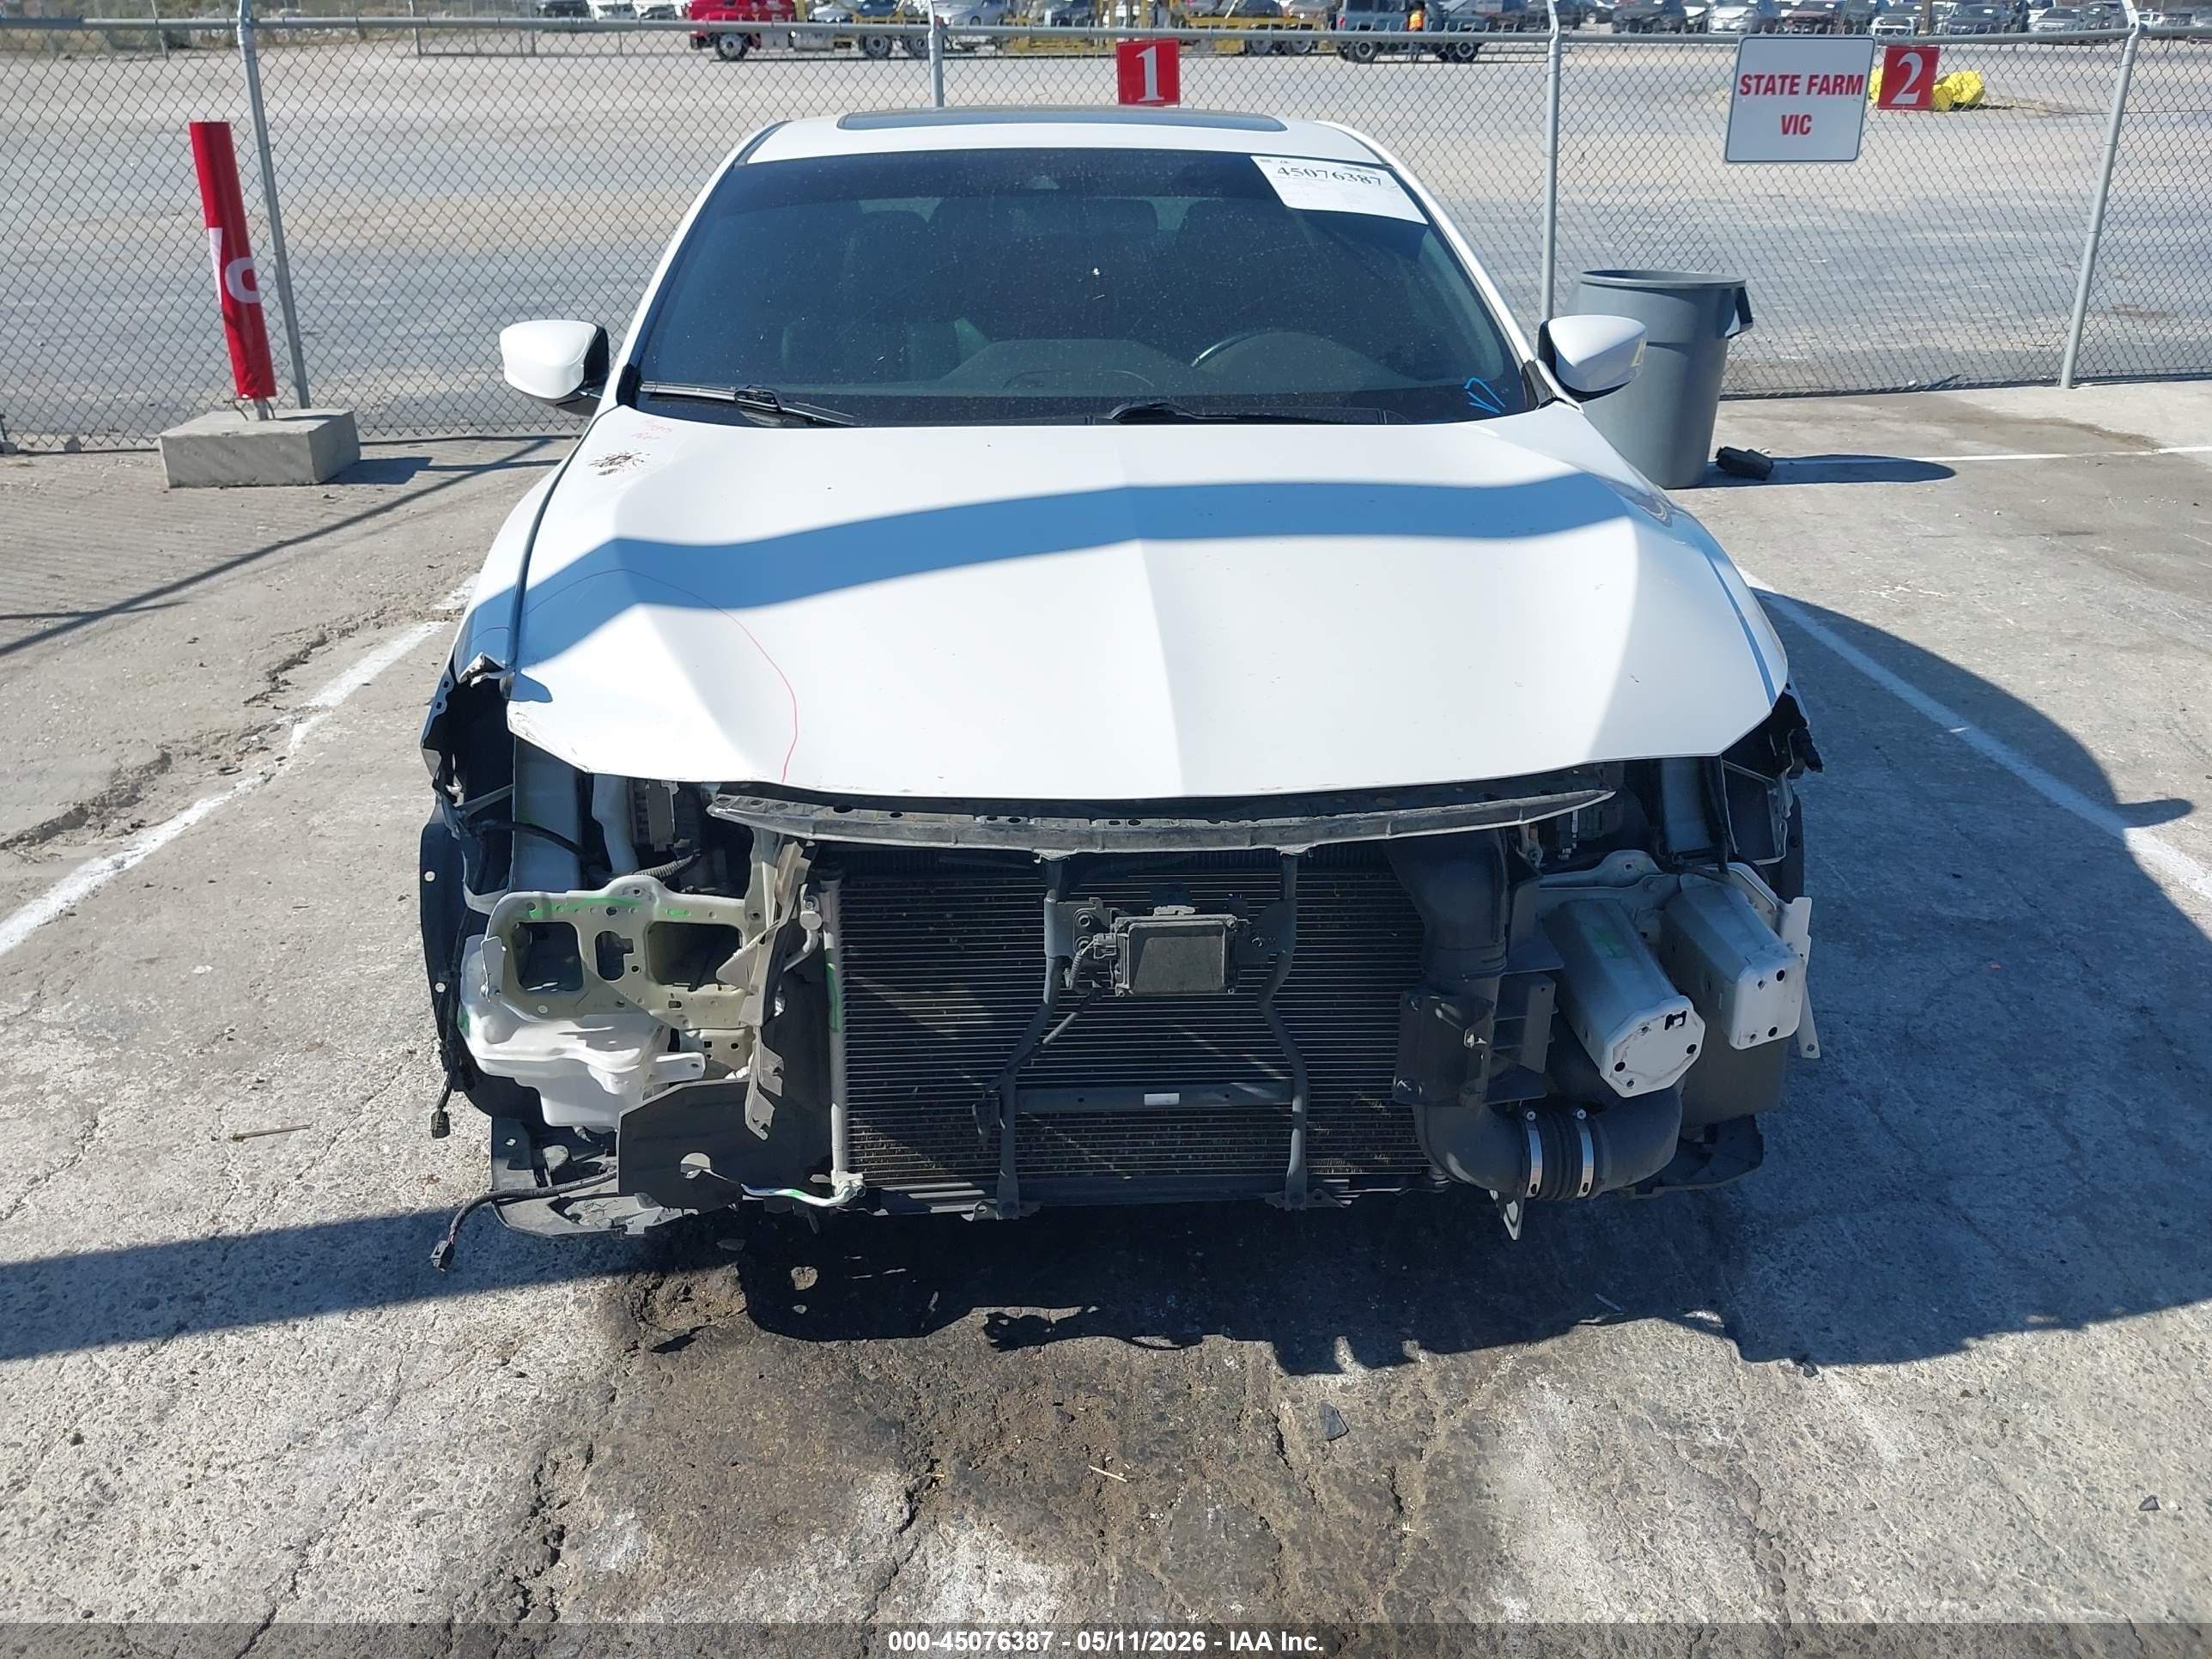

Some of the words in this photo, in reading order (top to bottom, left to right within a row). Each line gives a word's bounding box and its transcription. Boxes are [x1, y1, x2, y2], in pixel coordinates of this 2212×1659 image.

[1136, 46, 1164, 101] 1
[1891, 52, 1923, 105] 2
[1739, 74, 1801, 96] STATE
[1807, 74, 1863, 95] FARM
[1780, 114, 1813, 136] VIC
[1277, 167, 1382, 185] 45076387
